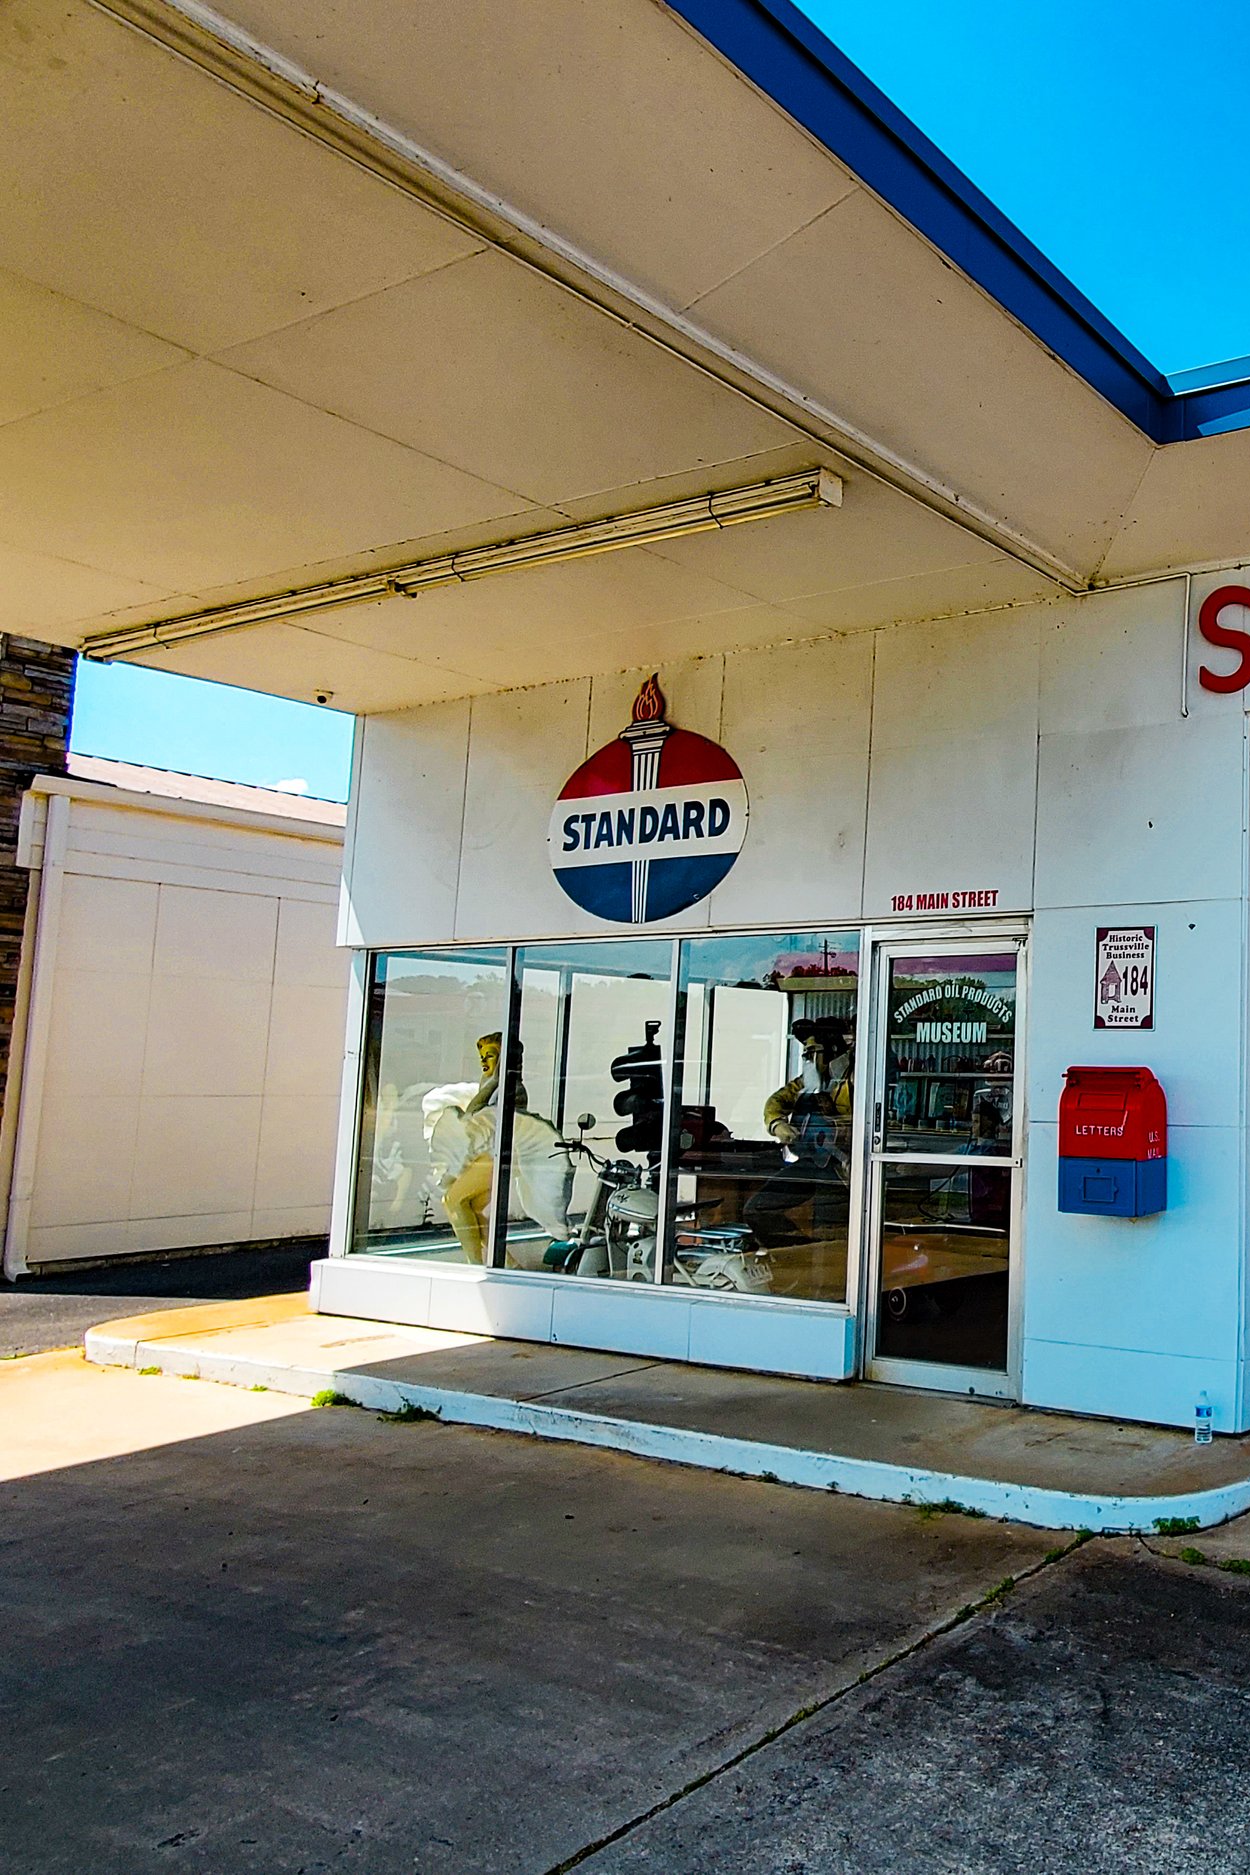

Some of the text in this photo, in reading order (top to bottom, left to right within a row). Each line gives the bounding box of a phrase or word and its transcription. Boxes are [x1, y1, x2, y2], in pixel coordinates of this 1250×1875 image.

[562, 797, 731, 852] STANDARD
[890, 889, 999, 911] 184 MAIN STREET
[1102, 943, 1150, 951] Trussville
[1109, 934, 1143, 942] Historic
[1122, 965, 1148, 996] 184
[893, 983, 1013, 1023] STANDARD OIL PRODUCTS
[1111, 1005, 1136, 1013] Main
[916, 1022, 987, 1043] MUSEUM
[1076, 1125, 1123, 1136] LETTERS
